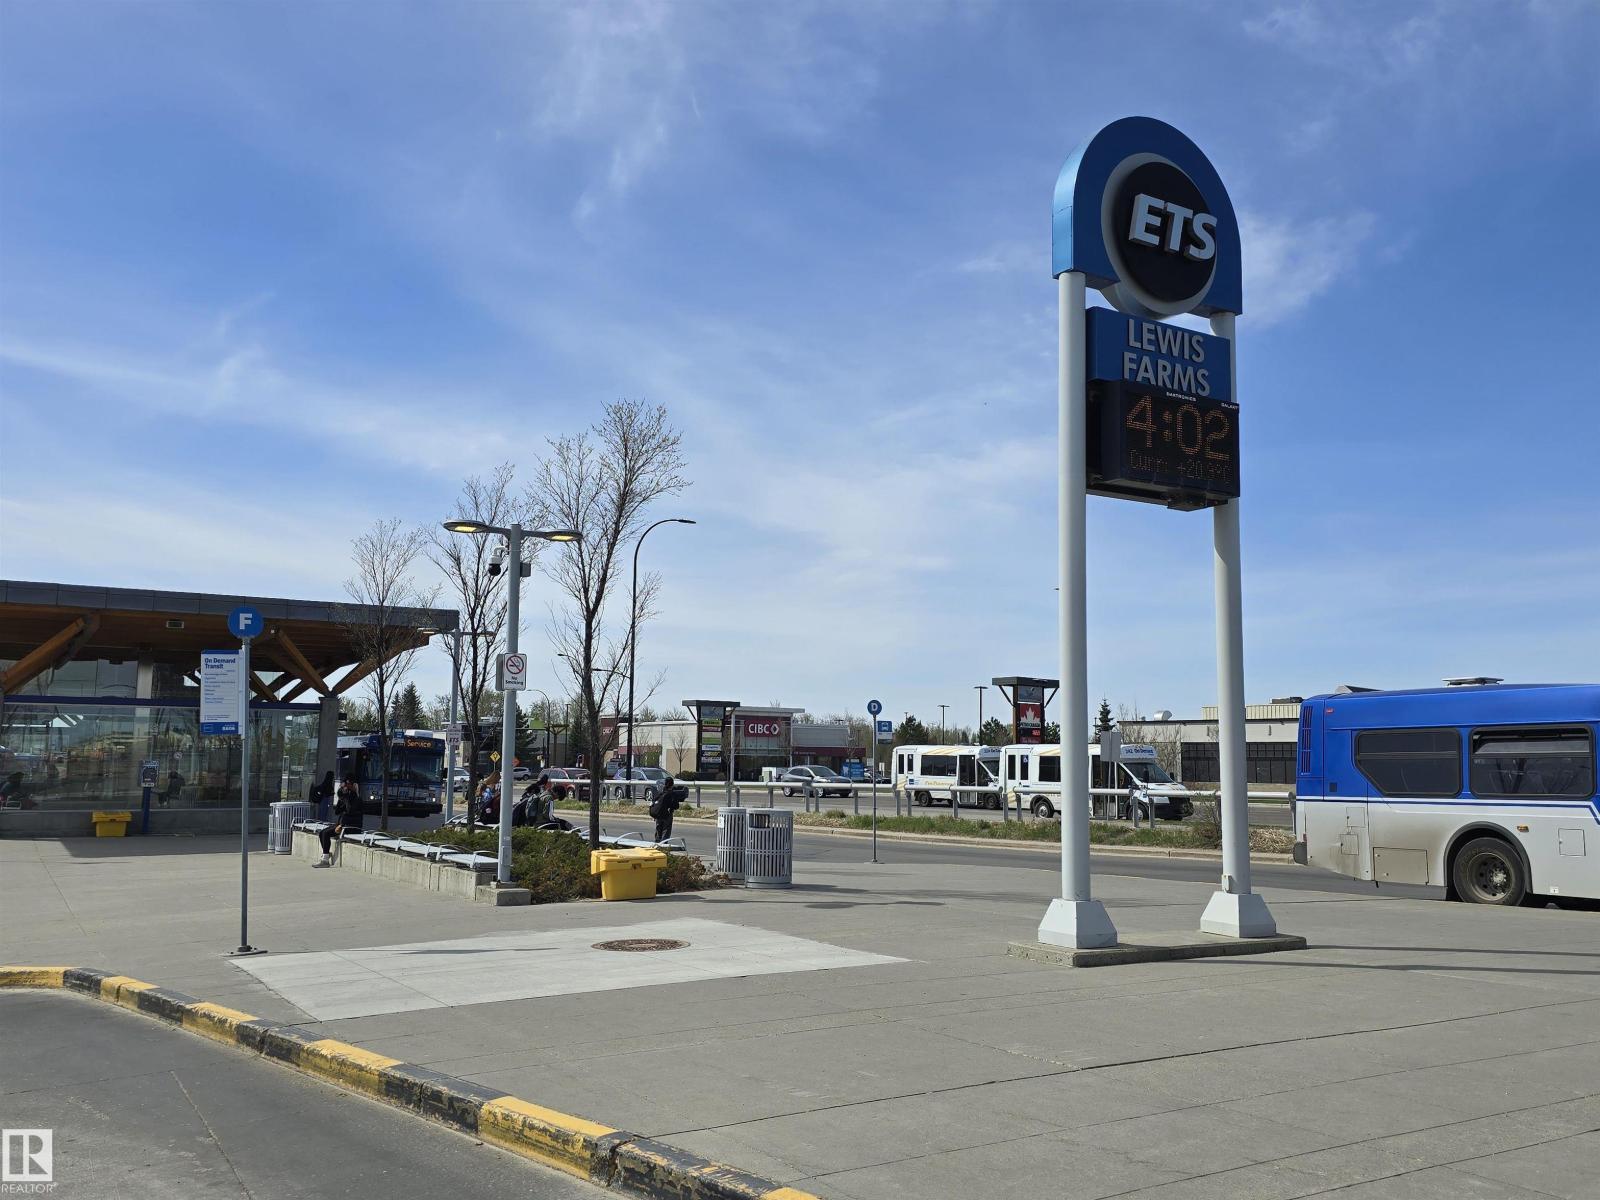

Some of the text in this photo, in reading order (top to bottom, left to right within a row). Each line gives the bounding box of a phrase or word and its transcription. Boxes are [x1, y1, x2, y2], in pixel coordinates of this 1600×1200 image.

[1129, 193, 1217, 260] ETS
[1128, 319, 1205, 363] LEWIS
[1123, 351, 1210, 396] FARMS
[1126, 394, 1230, 460] 4:02
[239, 613, 253, 630] F
[871, 702, 879, 712] D
[407, 739, 432, 748] Service
[748, 723, 771, 735] CIBC
